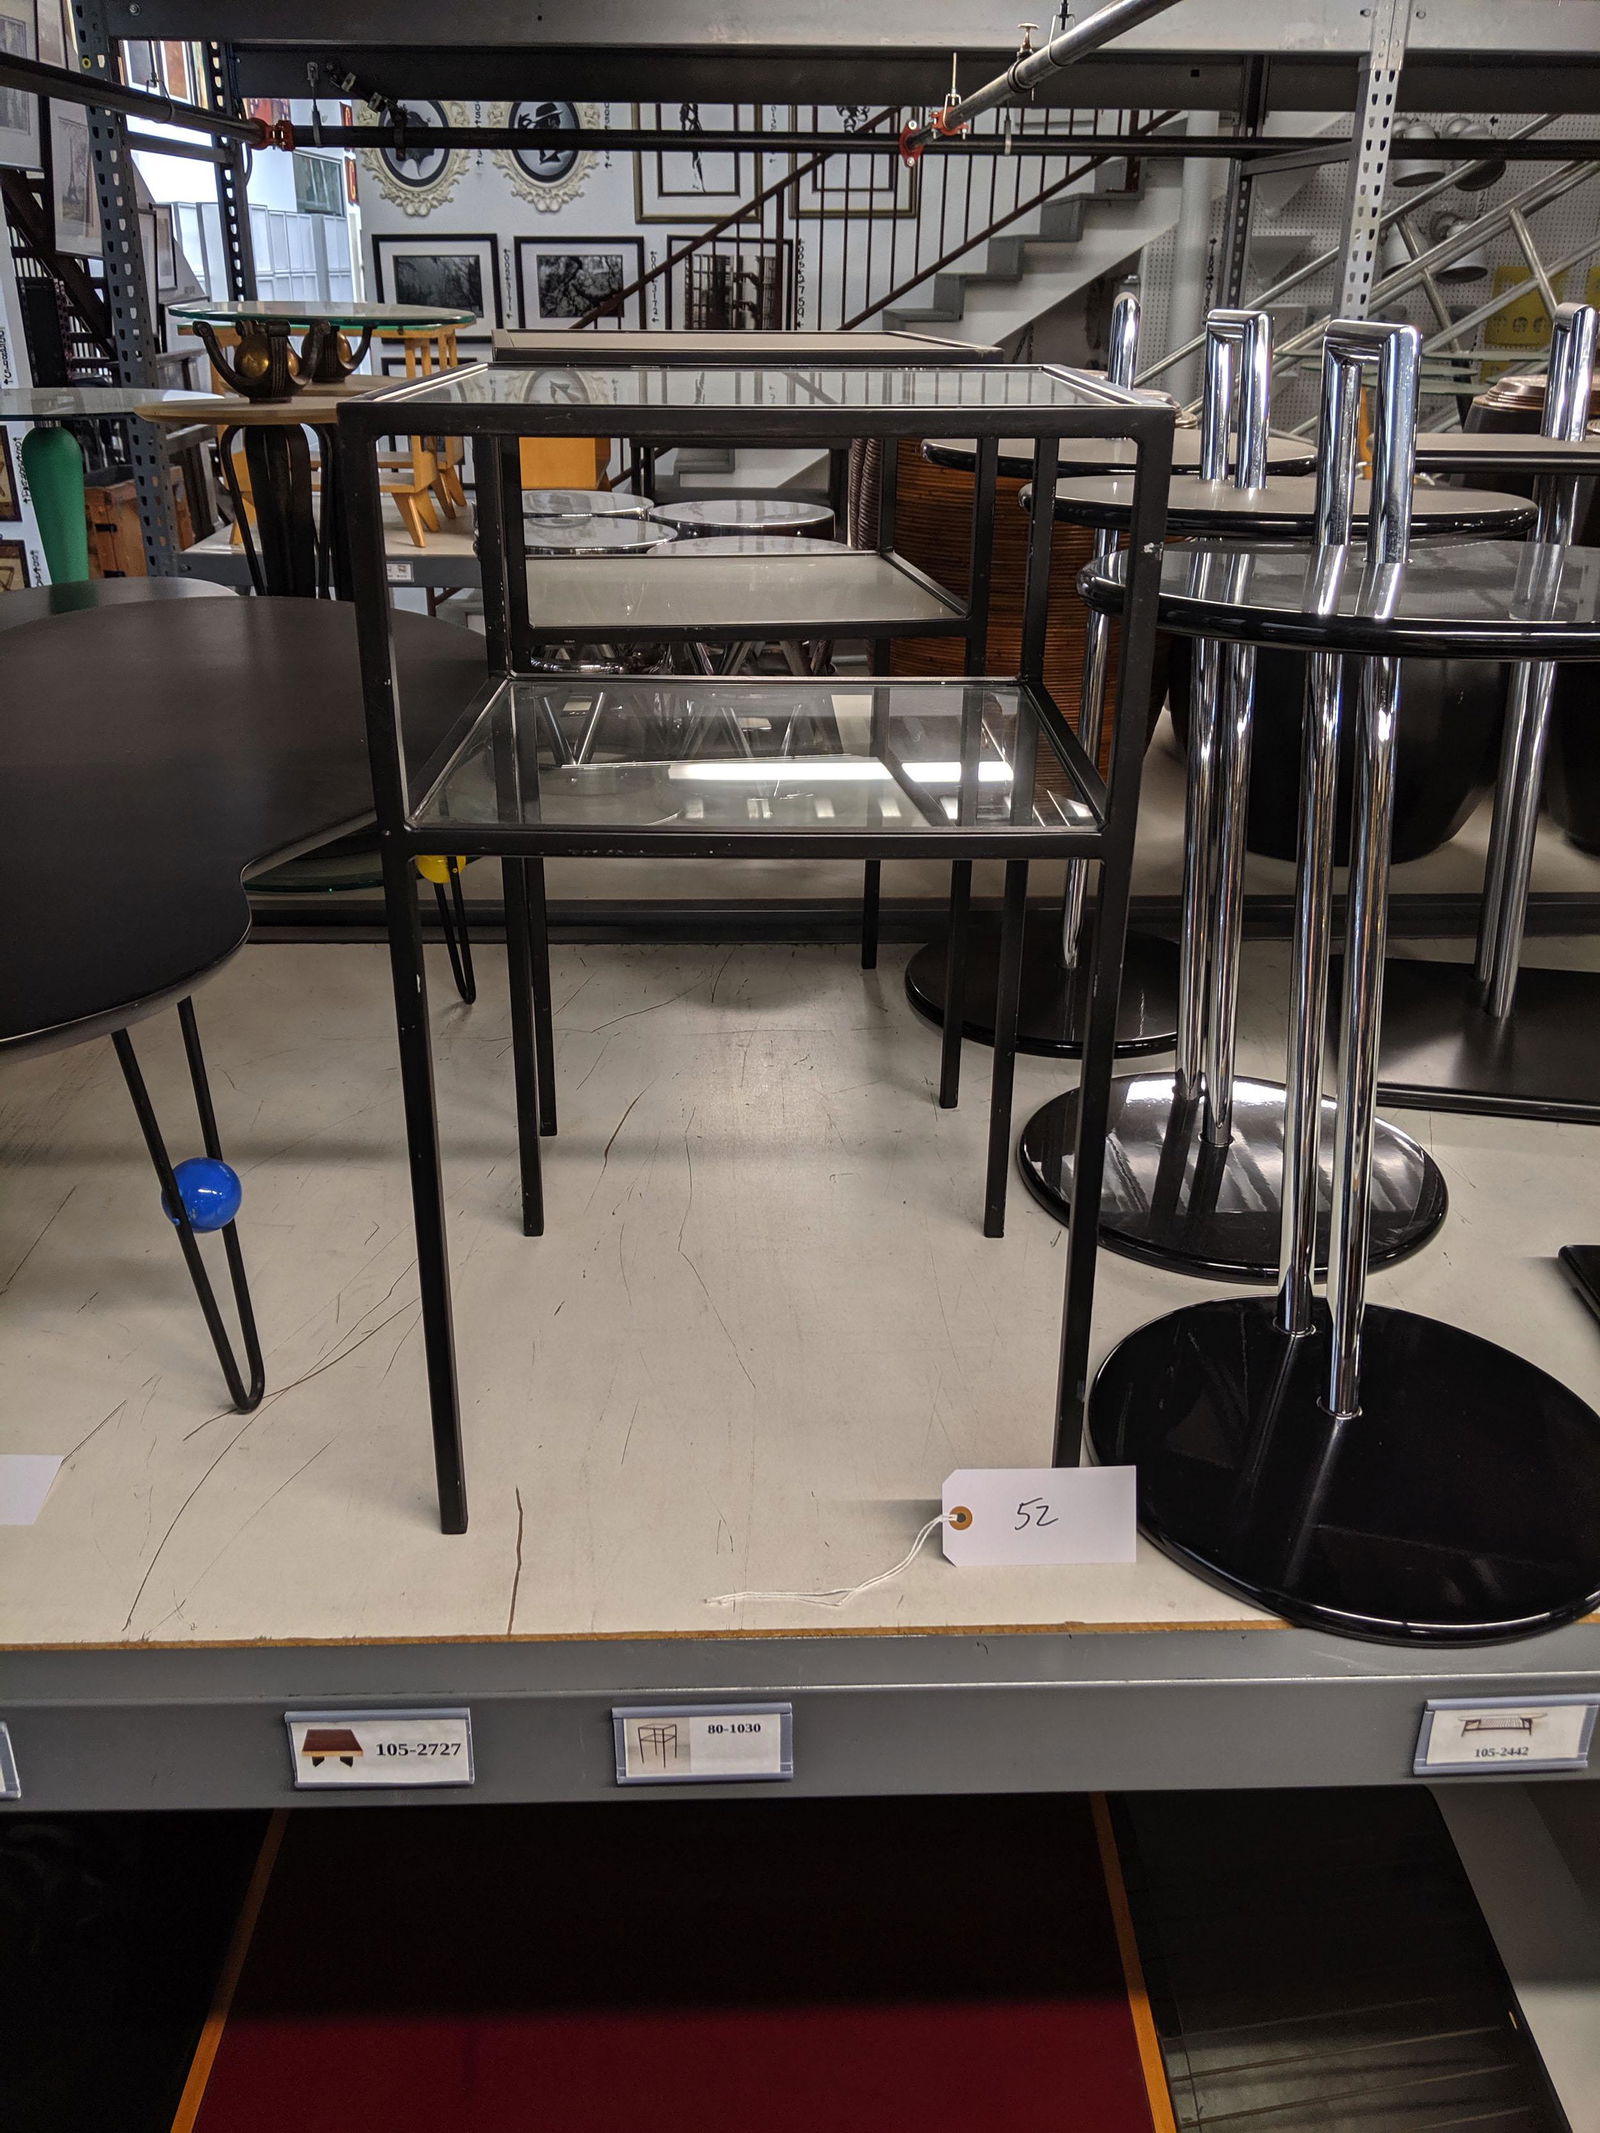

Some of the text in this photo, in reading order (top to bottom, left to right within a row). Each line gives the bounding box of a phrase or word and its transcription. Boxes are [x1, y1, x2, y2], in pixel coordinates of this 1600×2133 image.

[1014, 1496, 1060, 1531] 52
[707, 1722, 762, 1735] 80-1030
[375, 1742, 462, 1757] 105-2727
[1474, 1746, 1530, 1758] 105-2442
